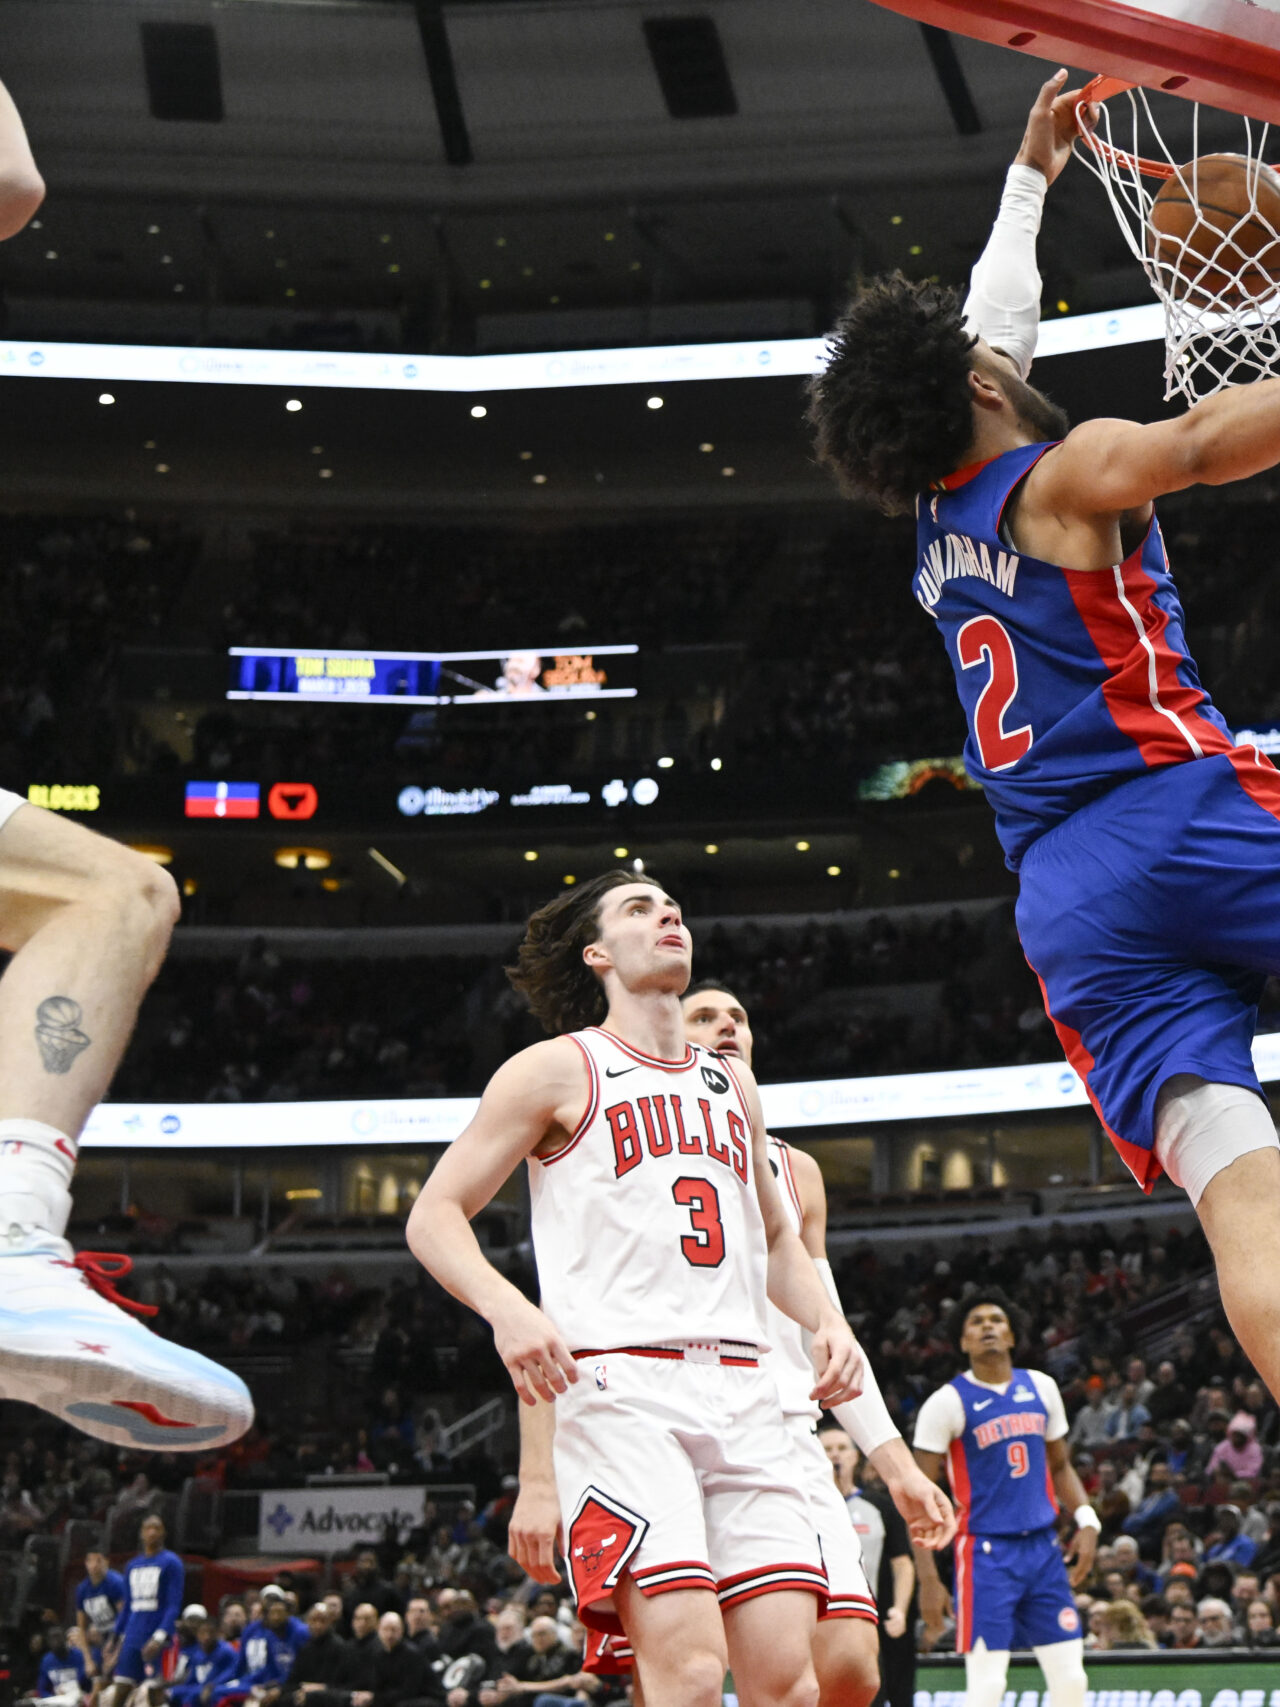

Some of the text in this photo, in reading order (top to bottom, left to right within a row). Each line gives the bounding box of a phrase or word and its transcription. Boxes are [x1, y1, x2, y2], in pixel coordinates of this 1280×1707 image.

[957, 615, 1033, 772] 2
[605, 1094, 748, 1185] BULLS
[672, 1176, 726, 1268] 3
[1007, 1441, 1030, 1478] 9
